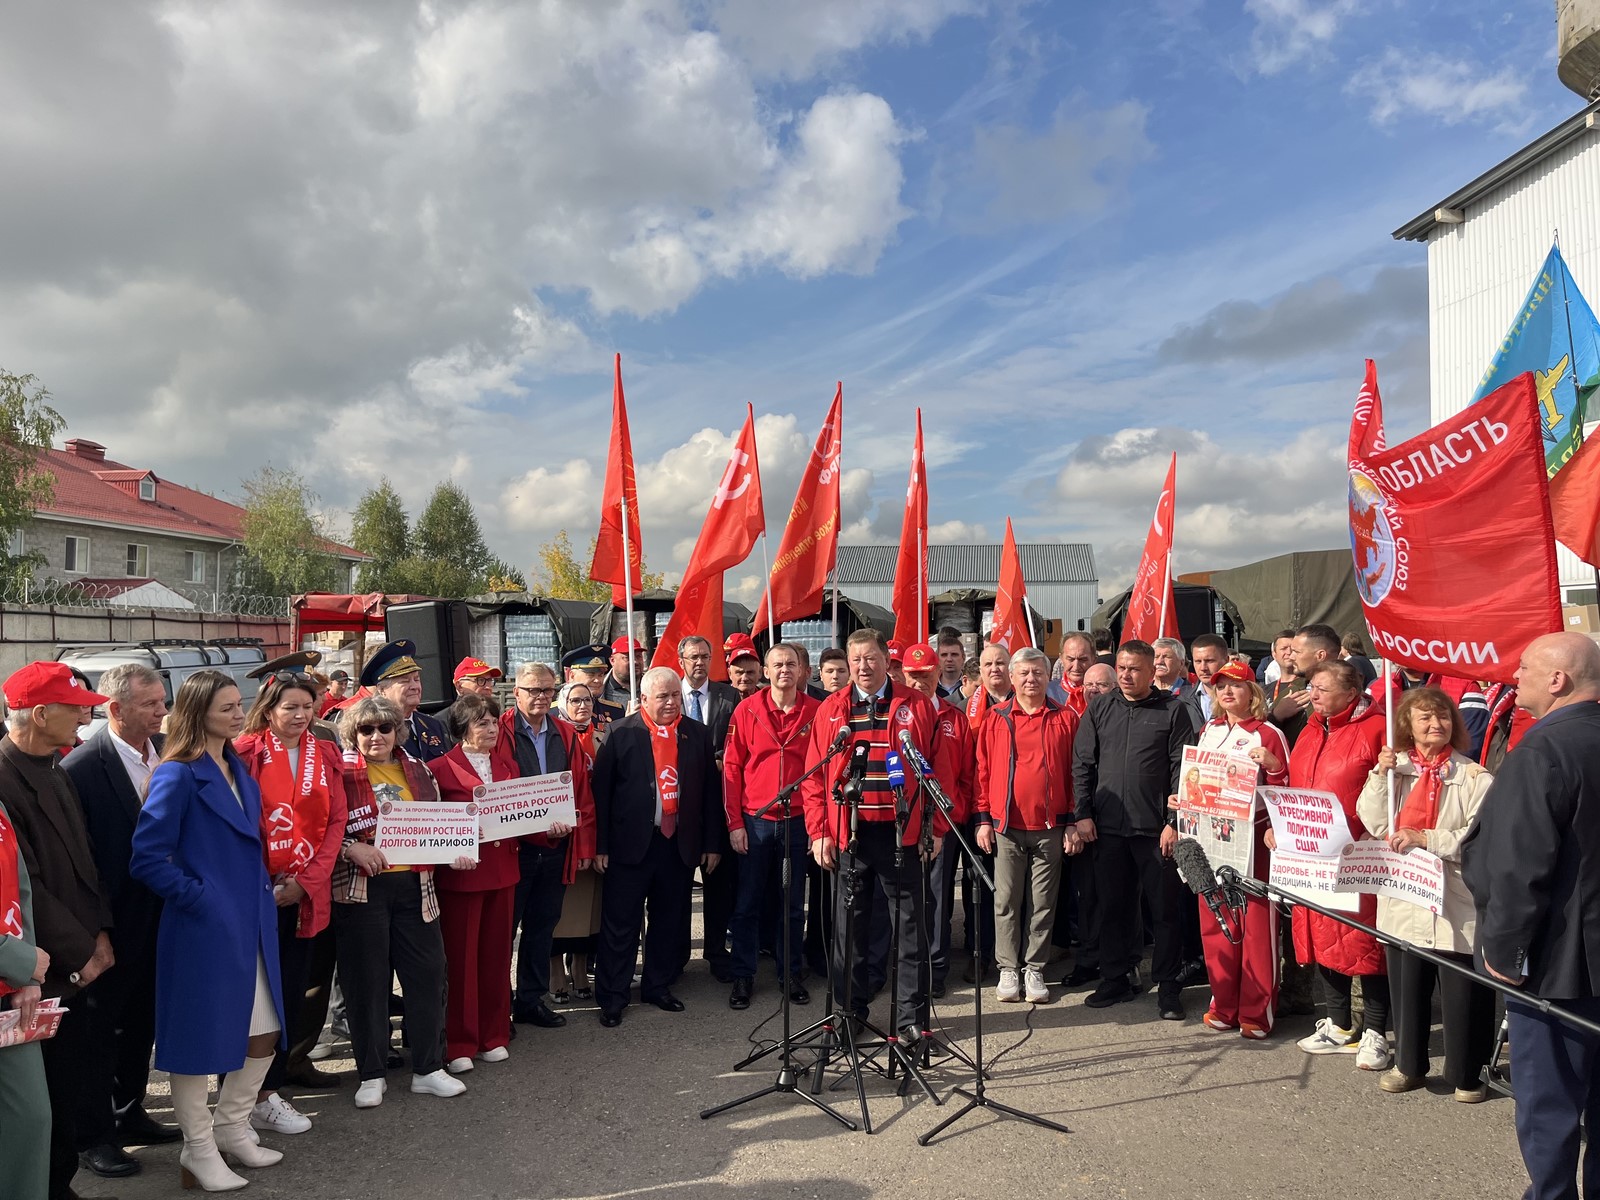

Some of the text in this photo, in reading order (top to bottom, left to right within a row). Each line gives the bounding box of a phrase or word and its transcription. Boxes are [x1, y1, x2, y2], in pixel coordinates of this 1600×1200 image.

[1379, 416, 1508, 492] ОБЛАСТЬ
[1395, 536, 1410, 591] СОЮЗ
[1381, 630, 1499, 664] РОССИИ
[531, 794, 569, 807] РОССИИ
[1280, 793, 1333, 809] МЫ ПРОТИВ
[348, 804, 372, 820] ДЕТИ
[500, 808, 549, 824] НАРОДУ
[1277, 805, 1334, 825] АГРЕССИВНОЙ
[381, 826, 475, 836] ОСТАНОВИМ РОСТ ЦЕН,
[1286, 821, 1329, 840] ПОЛИТИКИ
[380, 838, 475, 849] ДОЛГОВ И ТАРИФОВ
[1295, 838, 1320, 853] США!
[1272, 864, 1310, 877] ЗДОРОВЬЕ
[1315, 870, 1327, 879] НЕ
[1339, 865, 1389, 875] ГОРОДАМ
[1391, 867, 1400, 877] И
[1402, 870, 1437, 890] СЕЛАМ
[1271, 875, 1312, 889] МЕДИЦИНА
[1318, 882, 1329, 891] НЕ
[1337, 877, 1443, 906] РАБОЧИЕ МЕСТА И РАЗВИТИЕ
